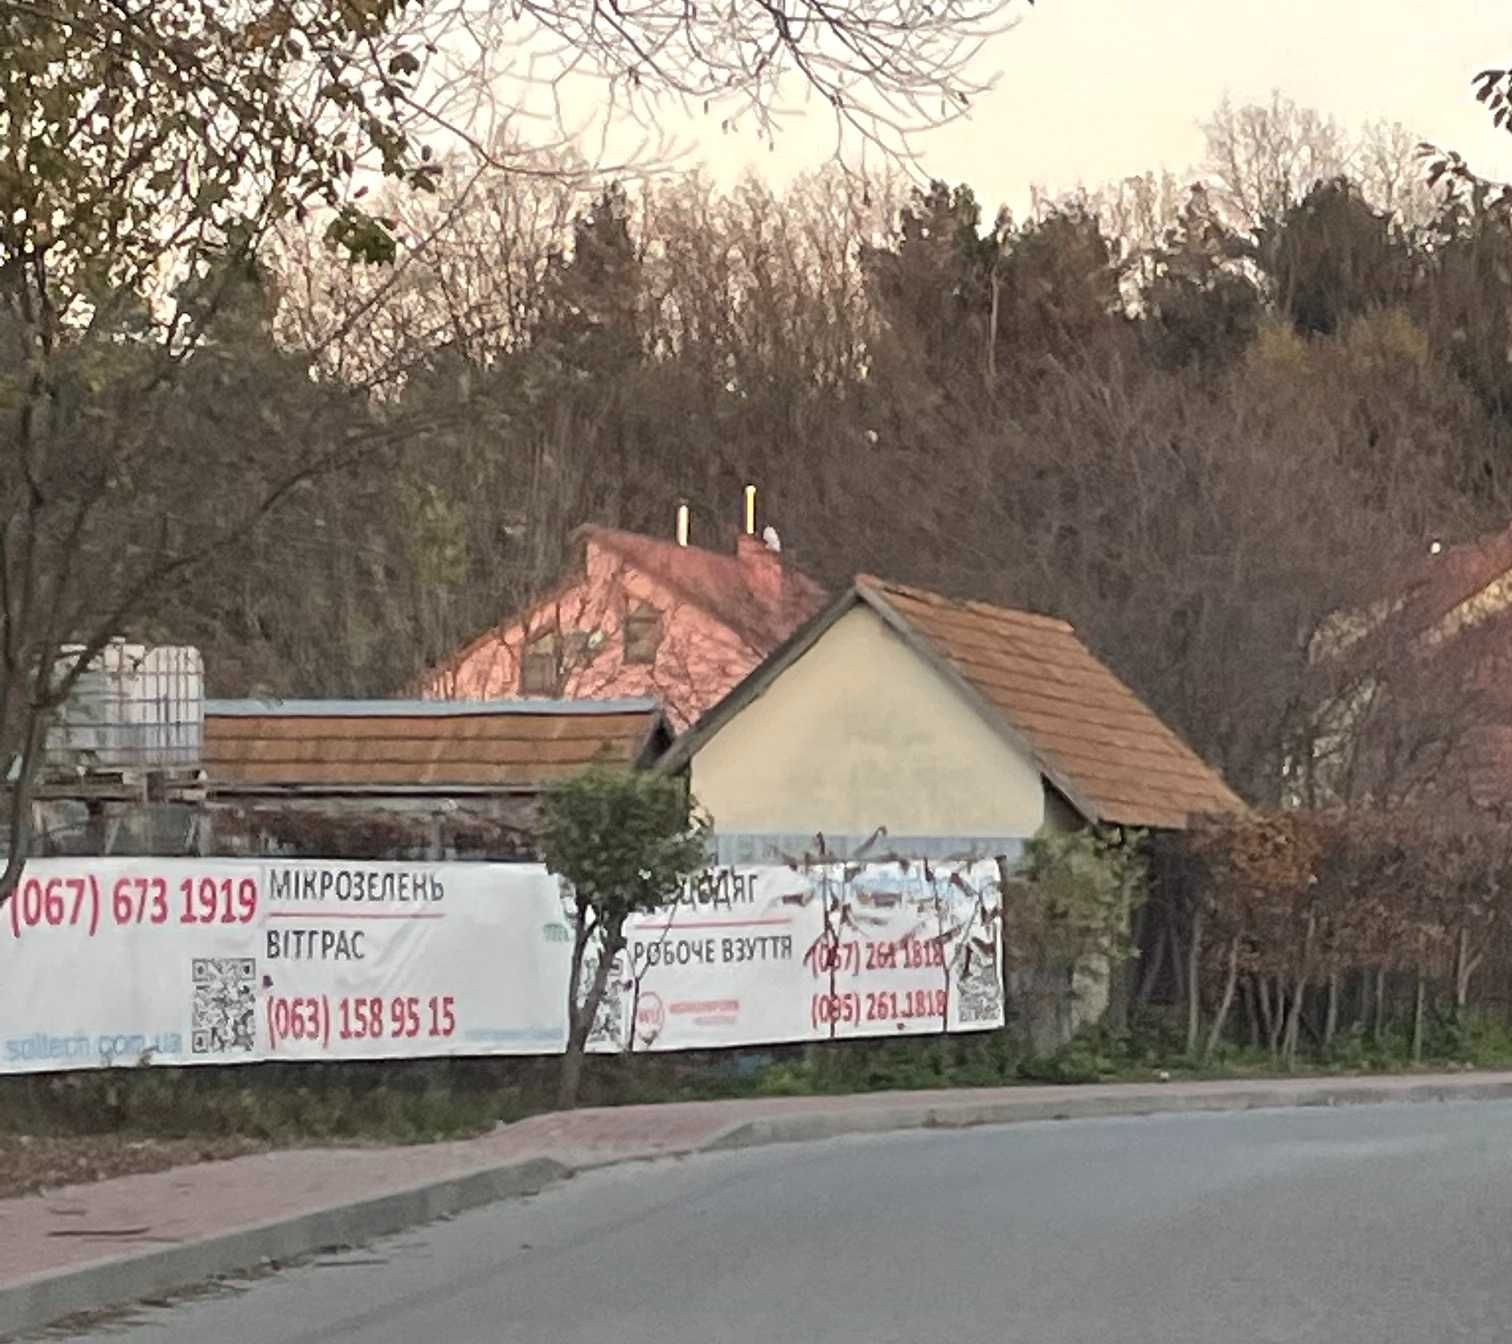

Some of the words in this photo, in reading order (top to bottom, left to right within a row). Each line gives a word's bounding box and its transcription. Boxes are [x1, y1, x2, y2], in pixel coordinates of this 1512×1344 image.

[268, 868, 446, 904] МІКРОЗЕЛЕНЬ
[9, 873, 100, 939] (067)
[112, 877, 168, 926] 673
[179, 876, 258, 925] 1919
[266, 928, 366, 961] ВІТГРАС
[633, 938, 716, 967] РОБОЧЕ
[721, 935, 793, 964] ВЗУТТЯ
[266, 994, 330, 1050] (063)
[339, 997, 384, 1040] 158
[390, 997, 421, 1039] 95
[429, 995, 456, 1037] 15
[865, 991, 898, 1021] 261
